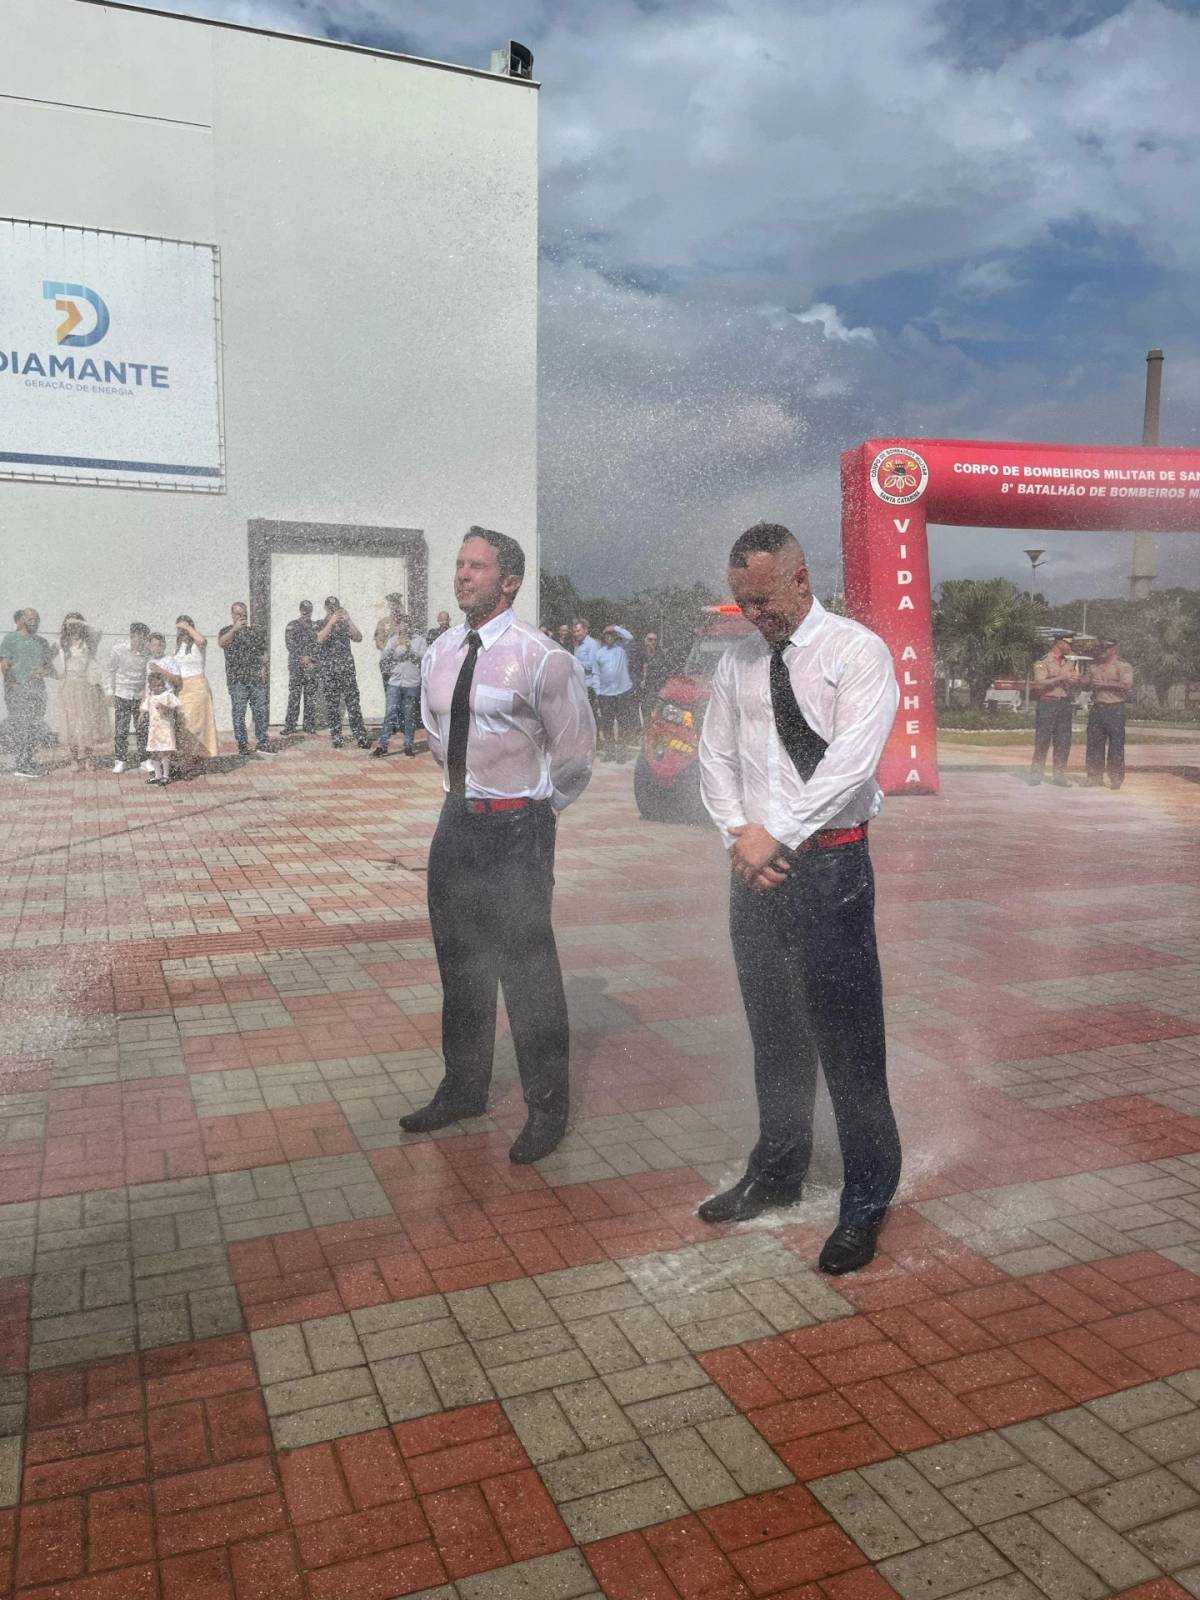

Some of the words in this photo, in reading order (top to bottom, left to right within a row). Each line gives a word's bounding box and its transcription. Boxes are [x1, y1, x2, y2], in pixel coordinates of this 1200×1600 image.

[24, 378, 73, 391] GERAÇÃO
[92, 386, 134, 396] ENERGIA
[953, 462, 999, 476] CORPO
[1002, 465, 1020, 477] DE
[1023, 466, 1100, 480] BOMBEIROS
[1104, 469, 1156, 481] MILITAR
[1159, 470, 1176, 481] DE
[1017, 483, 1086, 497] BATALHÃO
[1089, 486, 1107, 497] DE
[1110, 487, 1186, 499] BOMBEIROS
[893, 518, 915, 611] VIDA
[901, 645, 921, 783] ALHEIA
